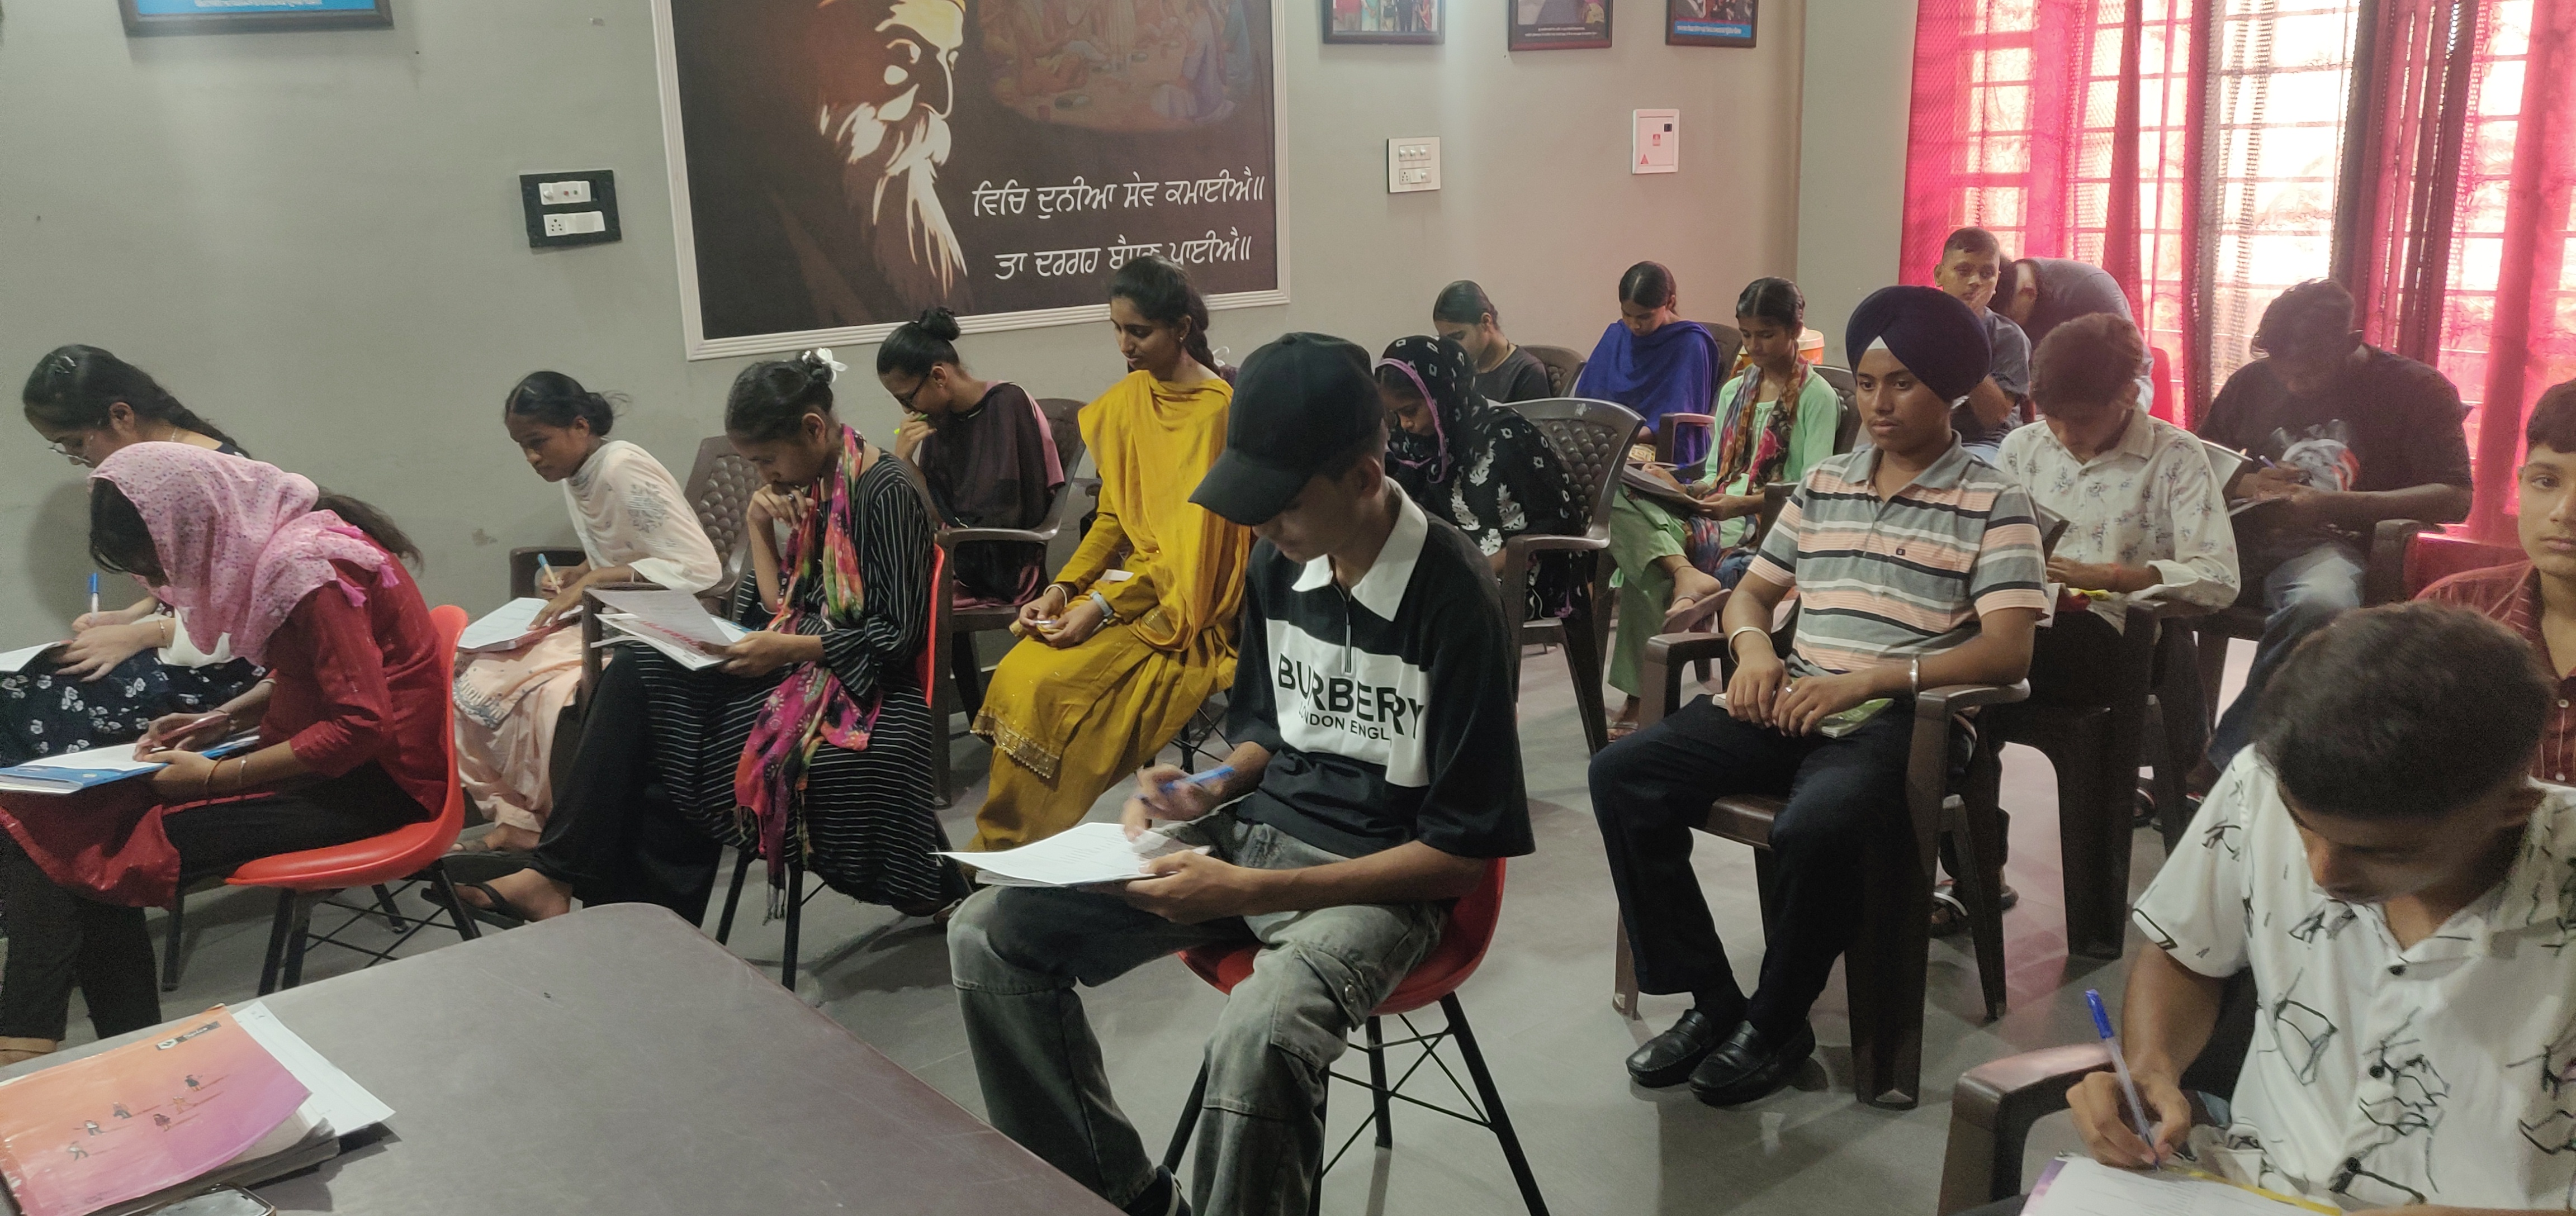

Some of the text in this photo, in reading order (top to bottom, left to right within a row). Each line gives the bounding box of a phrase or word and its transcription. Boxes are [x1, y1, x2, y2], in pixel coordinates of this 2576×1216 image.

[971, 179, 1030, 217] ਵਿਚਿ
[1036, 175, 1117, 220] ਦੁਨੀਆ
[1123, 171, 1159, 208] ਸੇਵ
[995, 253, 1028, 281] ਤਾ
[1034, 248, 1101, 277] ਦਰਗਹ
[1349, 719, 1391, 741] ENGL
